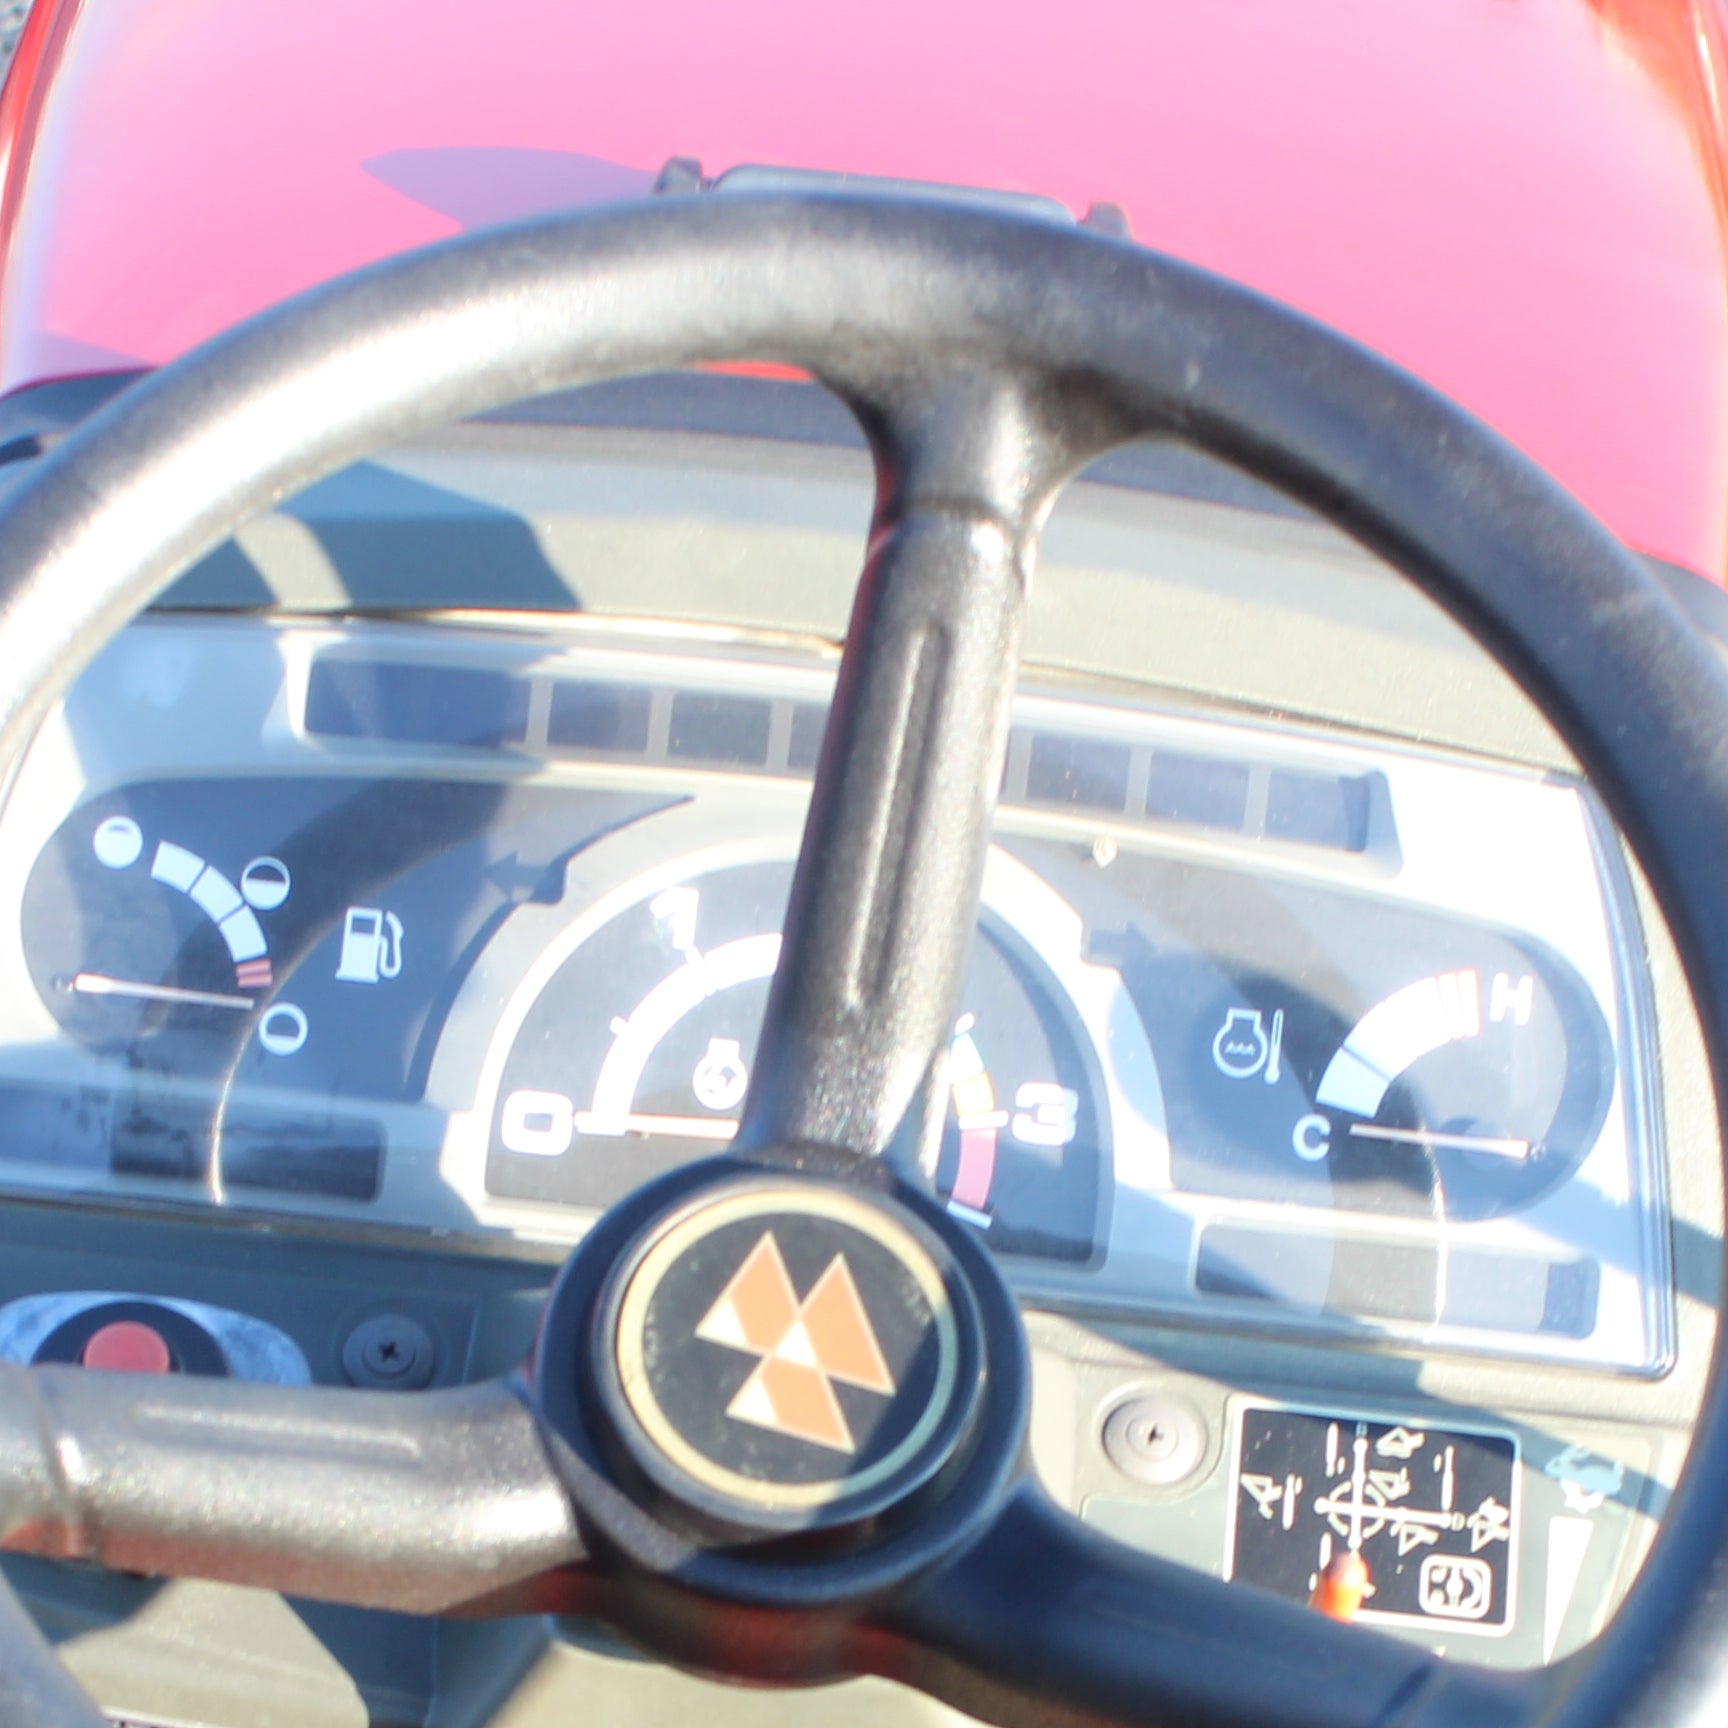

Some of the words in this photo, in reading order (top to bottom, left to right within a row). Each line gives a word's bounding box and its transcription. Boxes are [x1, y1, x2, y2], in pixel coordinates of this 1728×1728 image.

[650, 886, 700, 951] 1
[1489, 972, 1534, 1025] H
[1012, 1083, 1080, 1147] 3
[1292, 1113, 1332, 1162] C
